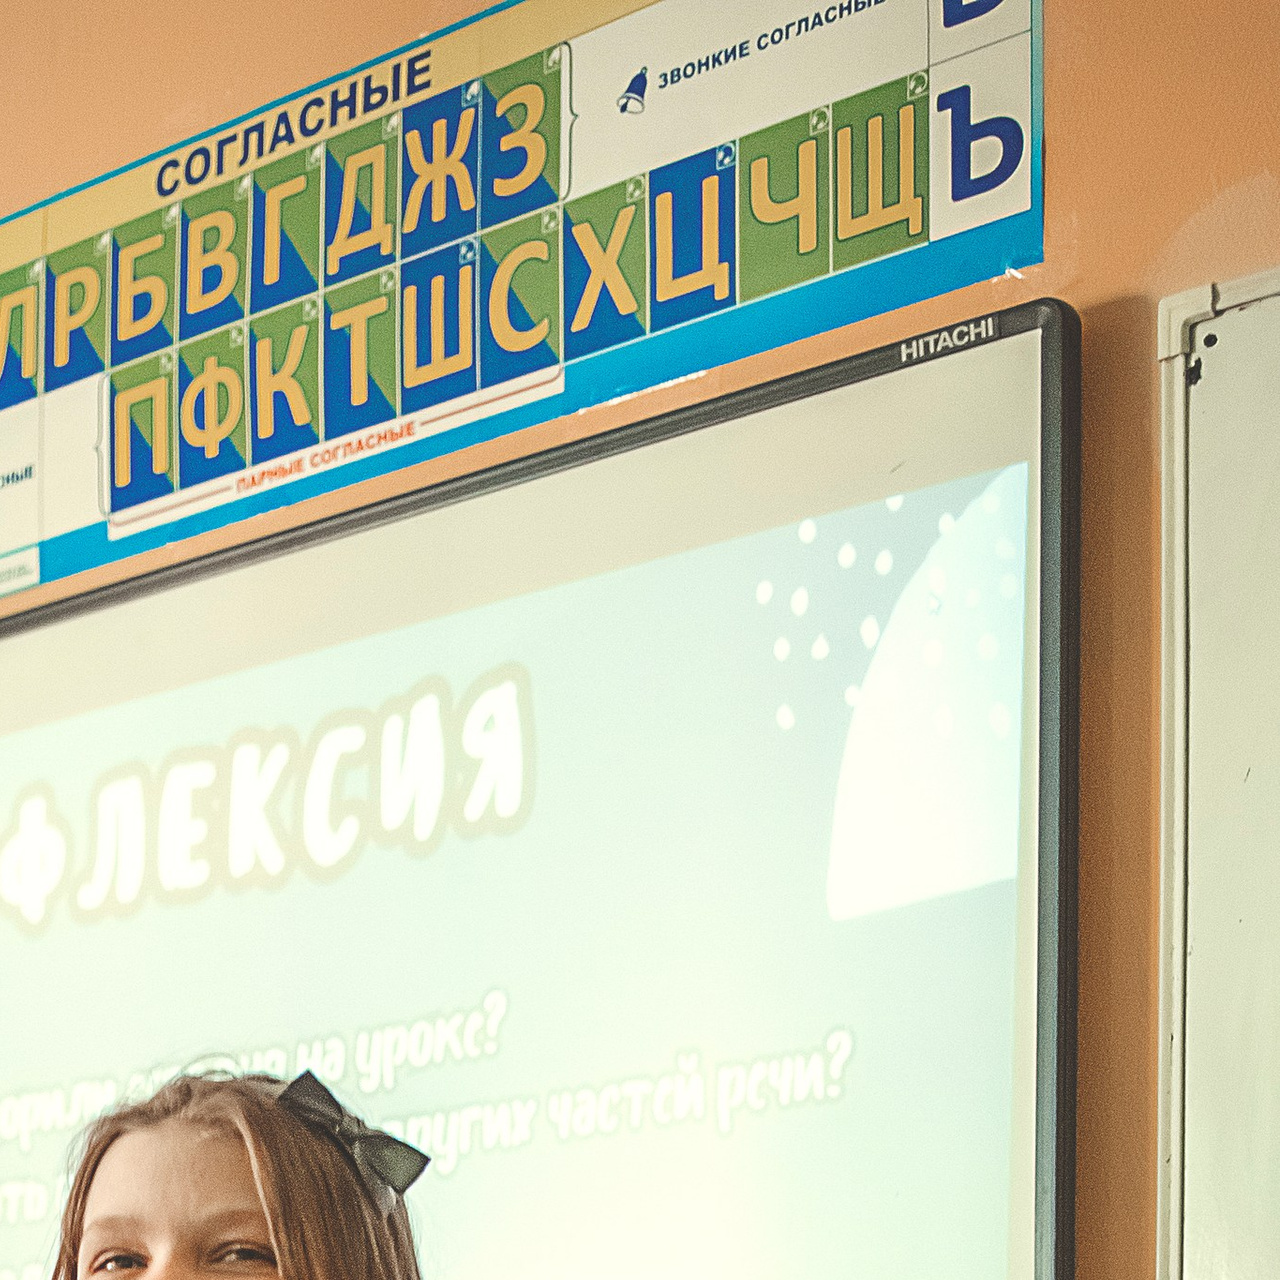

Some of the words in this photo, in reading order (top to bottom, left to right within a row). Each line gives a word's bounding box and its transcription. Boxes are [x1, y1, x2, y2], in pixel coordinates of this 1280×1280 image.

[658, 40, 750, 89] ЗВОНКИЕ
[756, 0, 886, 51] СОГЛАСНЫ
[156, 50, 433, 198] СОГЛАСНЫЕ
[900, 317, 994, 362] HITACHI
[309, 421, 416, 468] СОГЛАСНЫЕ
